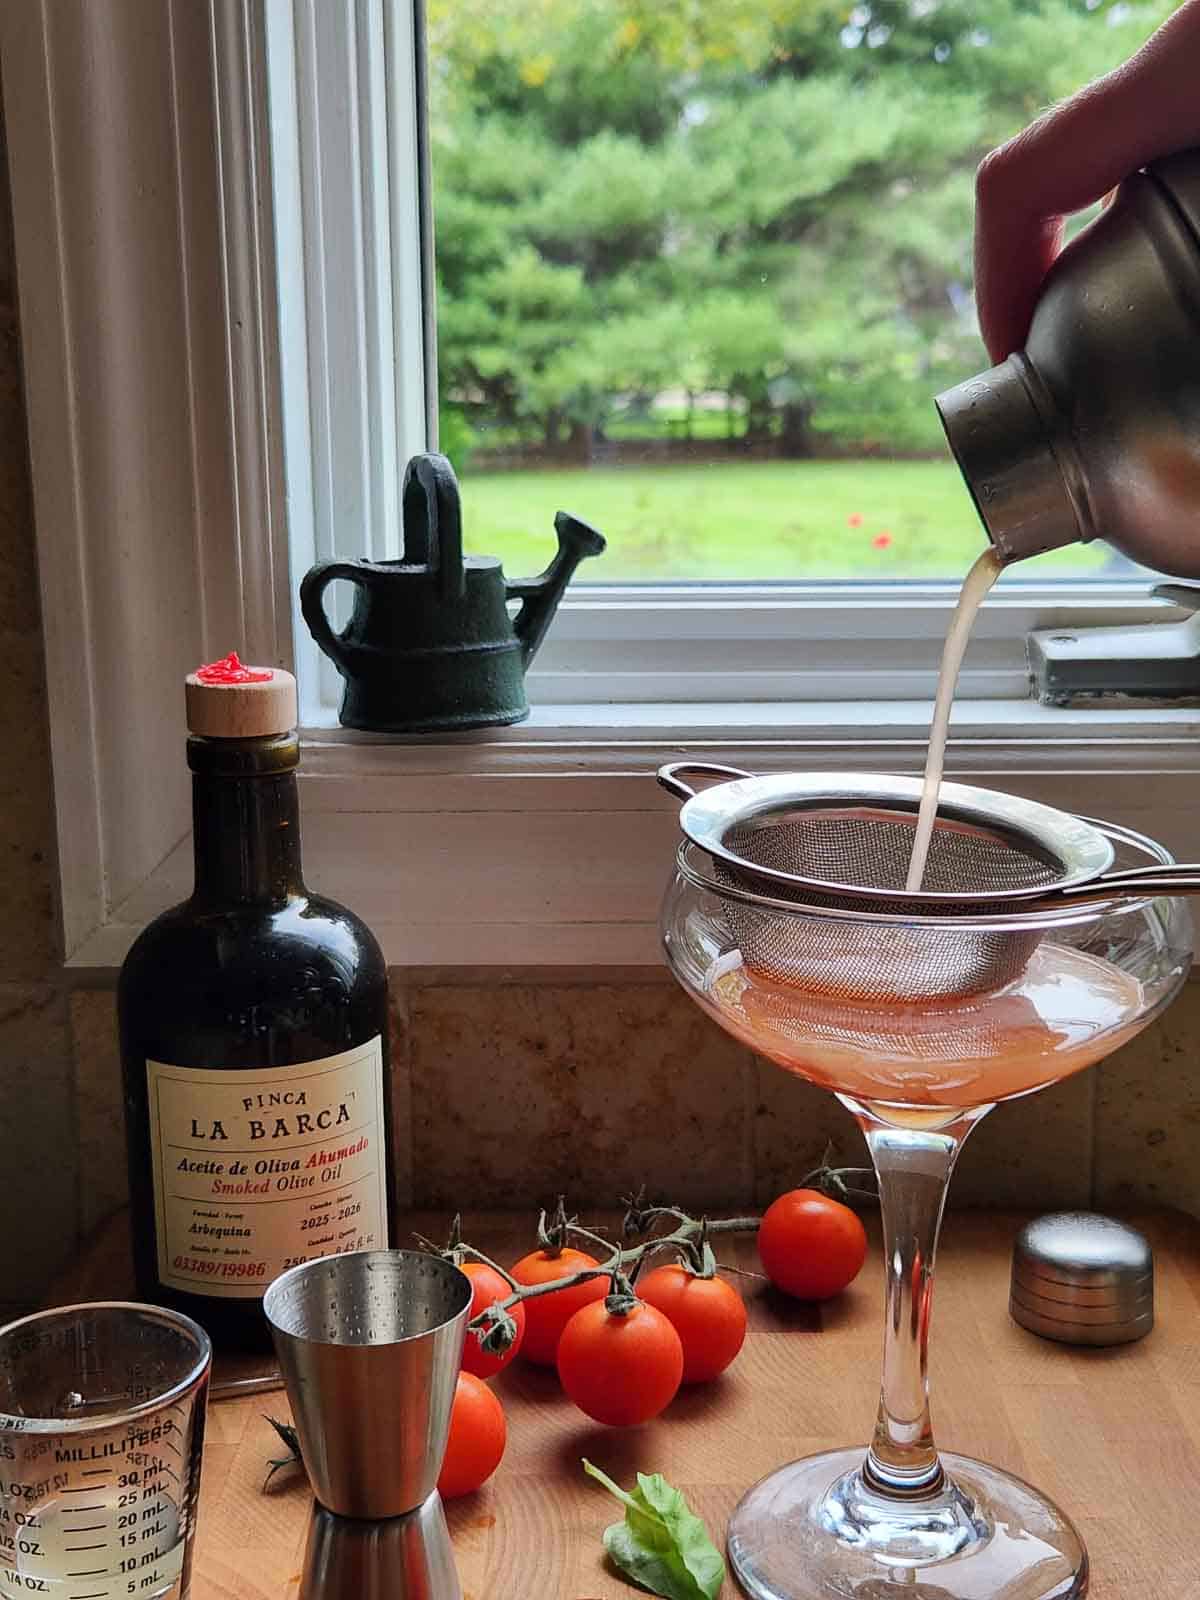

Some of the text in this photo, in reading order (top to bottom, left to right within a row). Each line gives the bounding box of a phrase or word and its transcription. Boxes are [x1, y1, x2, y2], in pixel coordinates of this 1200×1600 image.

[242, 1091, 307, 1112] FINCA
[190, 1103, 351, 1140] LA BARCA
[176, 1135, 370, 1176] Aceite de Oliva Ahumado
[211, 1164, 343, 1196] Smoked Olive Oil
[188, 1222, 252, 1240] Arbequina
[54, 1419, 174, 1464] MILLILITERS
[118, 1471, 139, 1488] 30
[118, 1491, 138, 1509] 25
[14, 1512, 42, 1529] OZ.
[118, 1512, 138, 1529] 20
[19, 1540, 45, 1556] OZ.
[119, 1531, 137, 1548] 15
[119, 1557, 138, 1574] 10
[4, 1569, 51, 1593] 1/4 OZ.
[127, 1580, 137, 1594] 5
